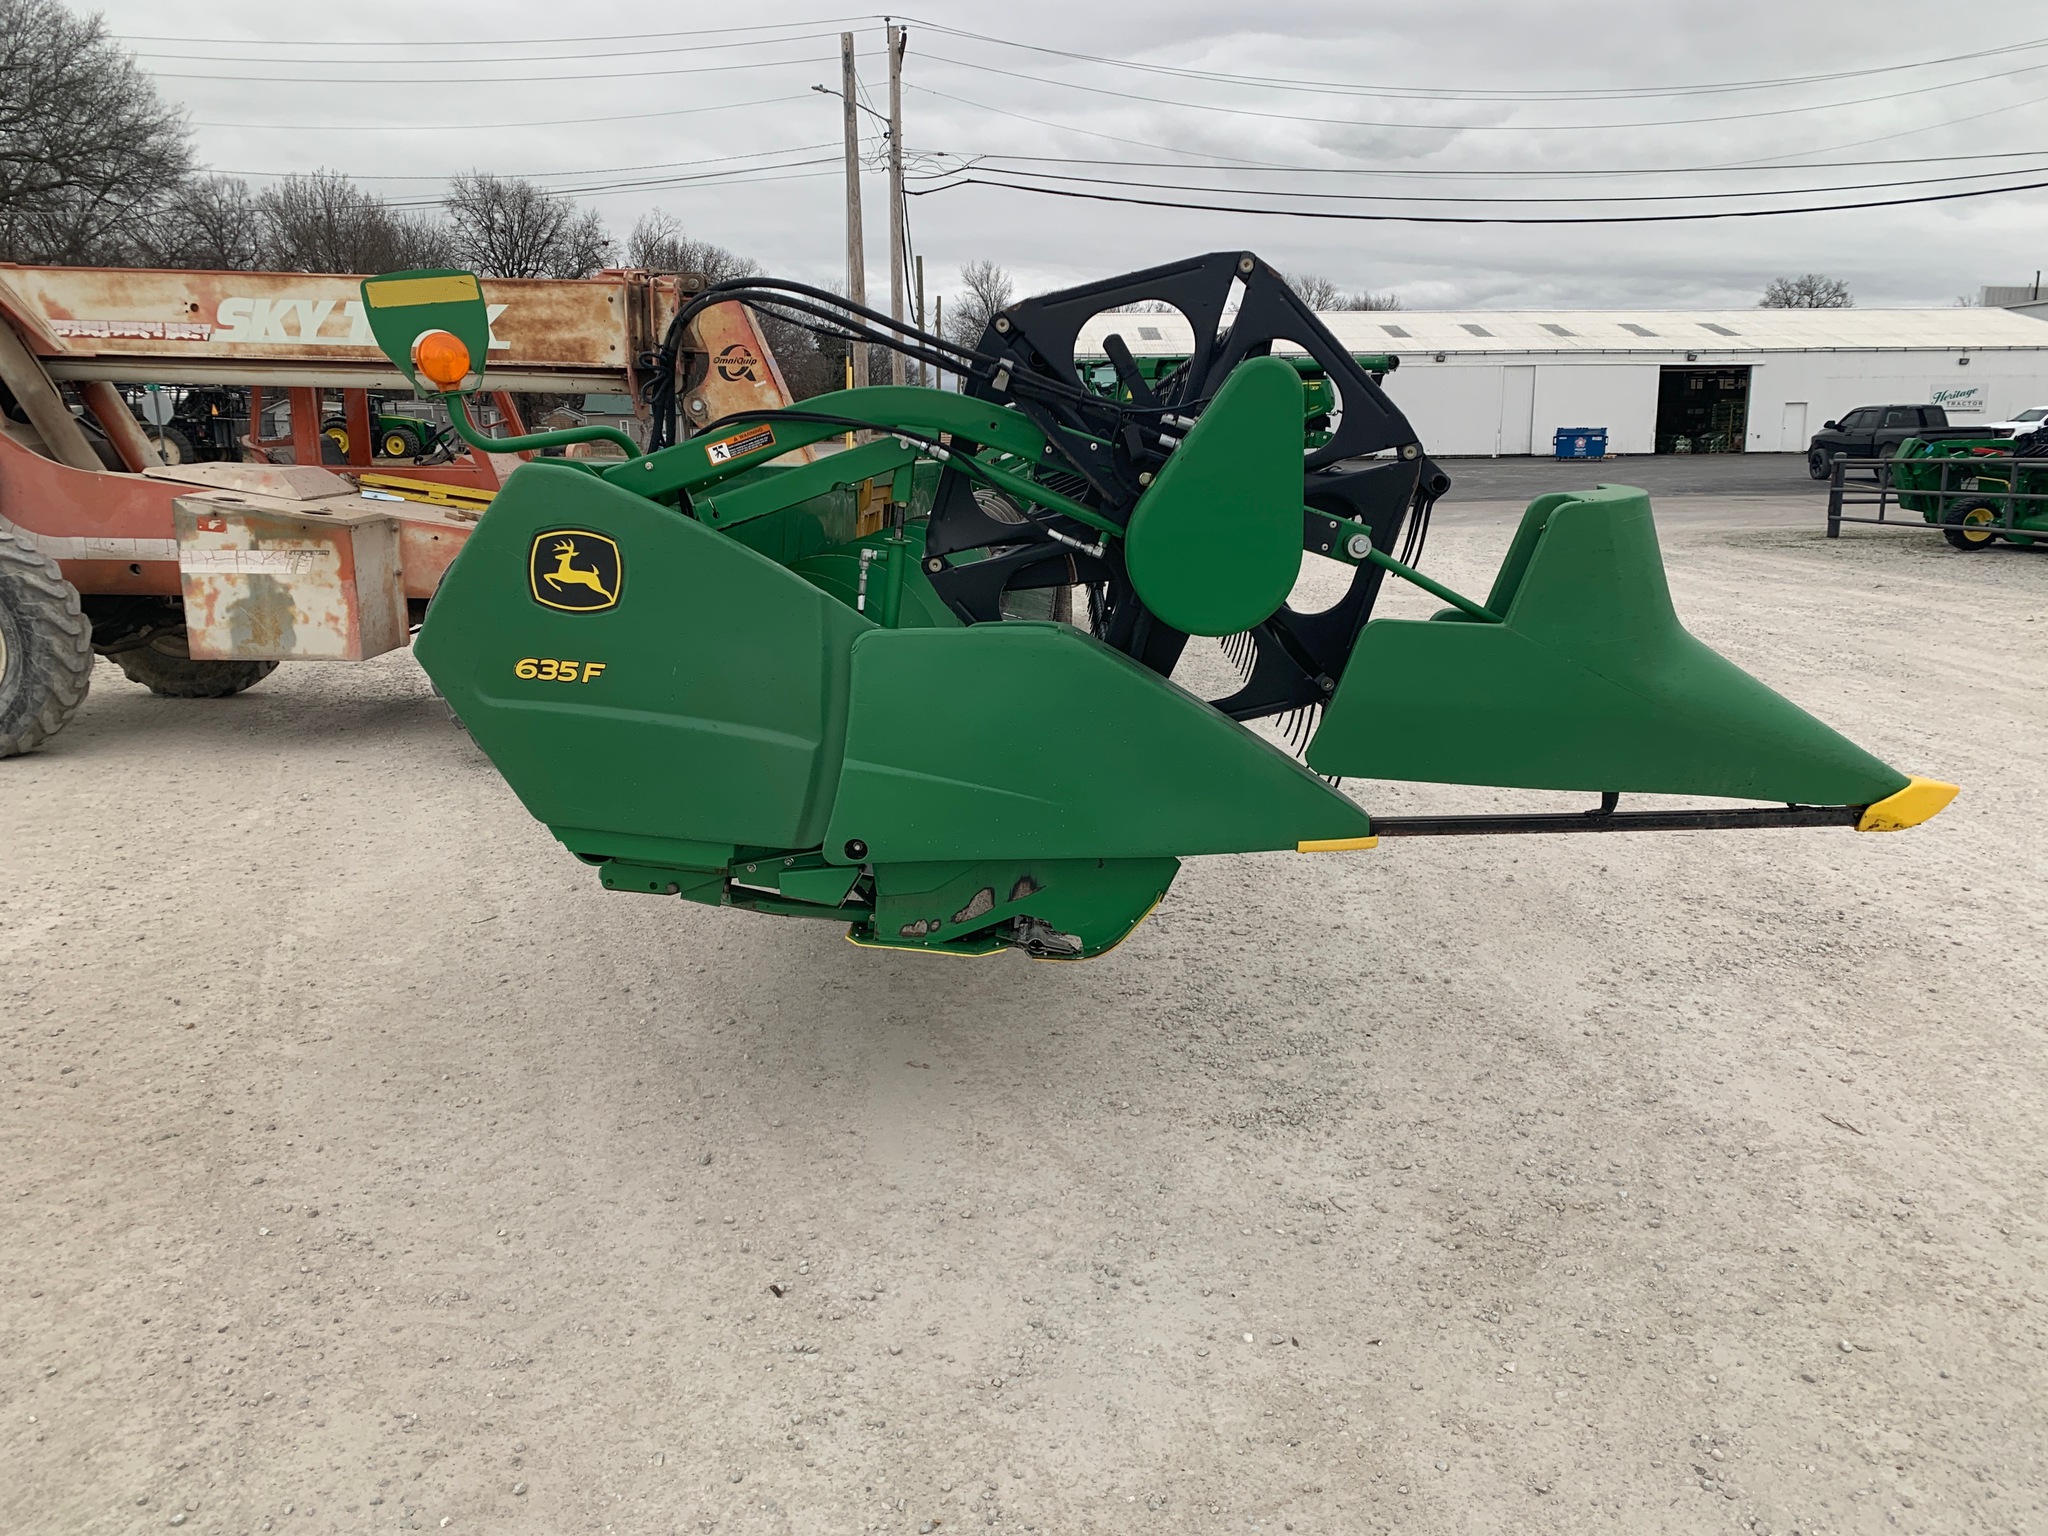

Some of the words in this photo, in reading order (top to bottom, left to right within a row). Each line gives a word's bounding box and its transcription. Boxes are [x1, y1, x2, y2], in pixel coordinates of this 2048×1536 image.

[713, 357, 757, 366] OmniQuip
[1931, 388, 1978, 405] Heritage
[738, 427, 764, 439] WARNING
